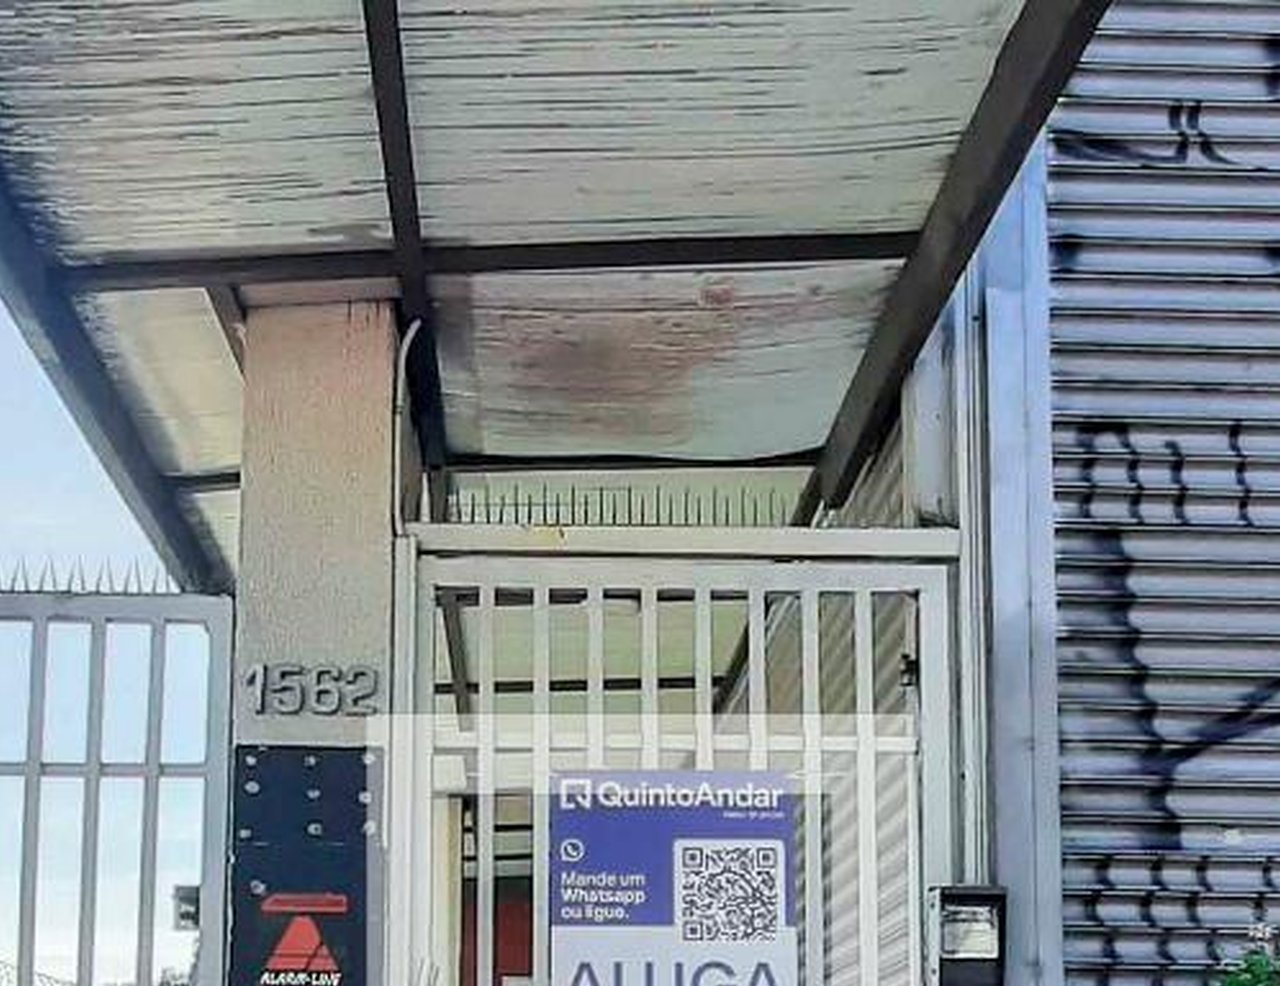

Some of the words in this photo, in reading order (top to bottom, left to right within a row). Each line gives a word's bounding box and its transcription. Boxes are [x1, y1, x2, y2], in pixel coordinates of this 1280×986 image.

[245, 664, 378, 715] 1562
[597, 781, 784, 808] QuintoAndar
[561, 871, 617, 887] Mande
[620, 874, 646, 887] um
[561, 887, 646, 905] Whatsapp
[561, 906, 583, 919] ou
